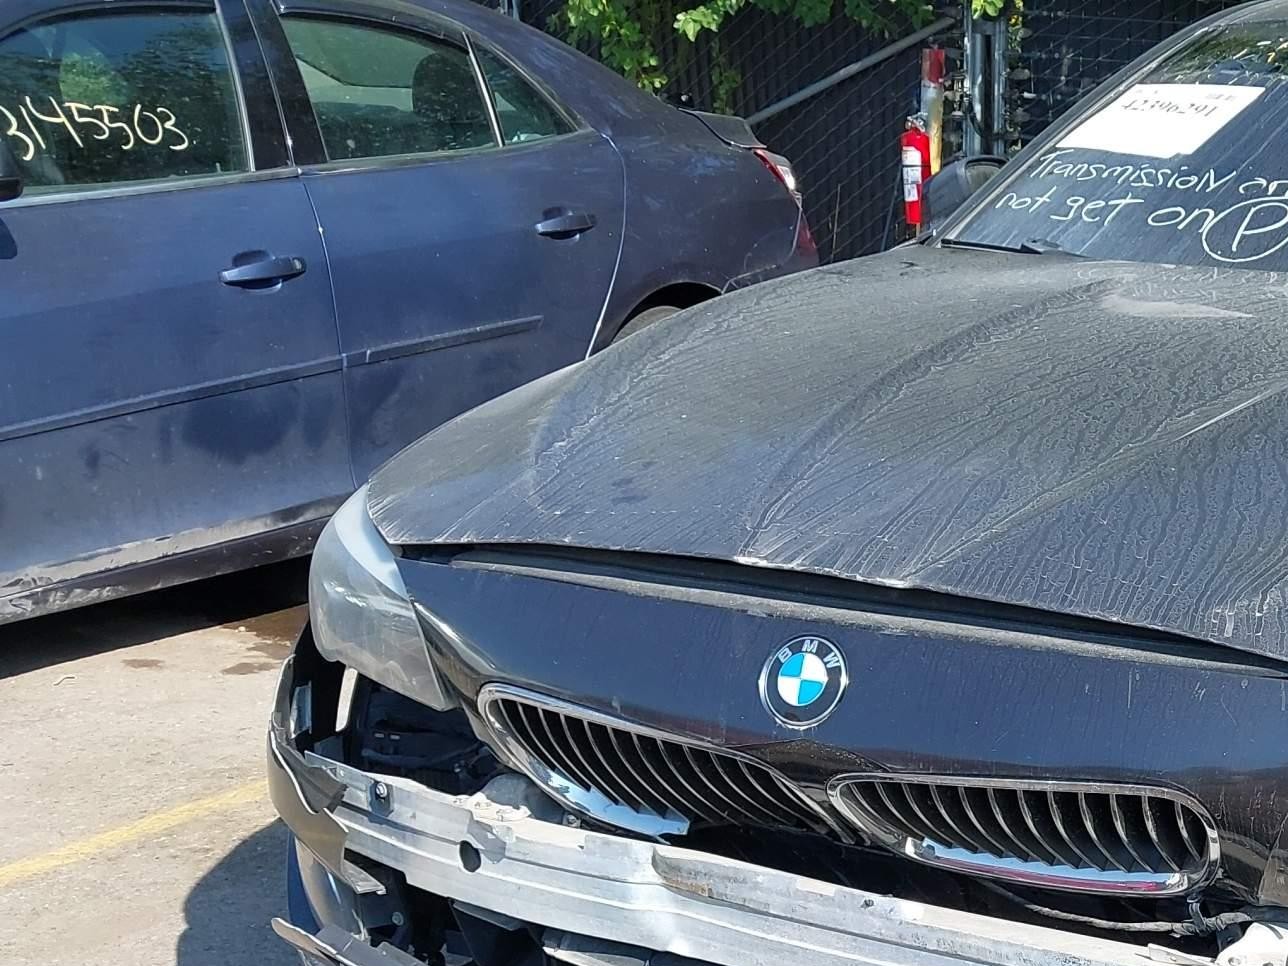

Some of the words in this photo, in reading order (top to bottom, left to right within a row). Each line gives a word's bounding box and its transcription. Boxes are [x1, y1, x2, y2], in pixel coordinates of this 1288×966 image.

[995, 185, 1057, 214] not
[1049, 192, 1145, 227] get
[1146, 206, 1216, 233] on
[777, 638, 842, 669] BMW
